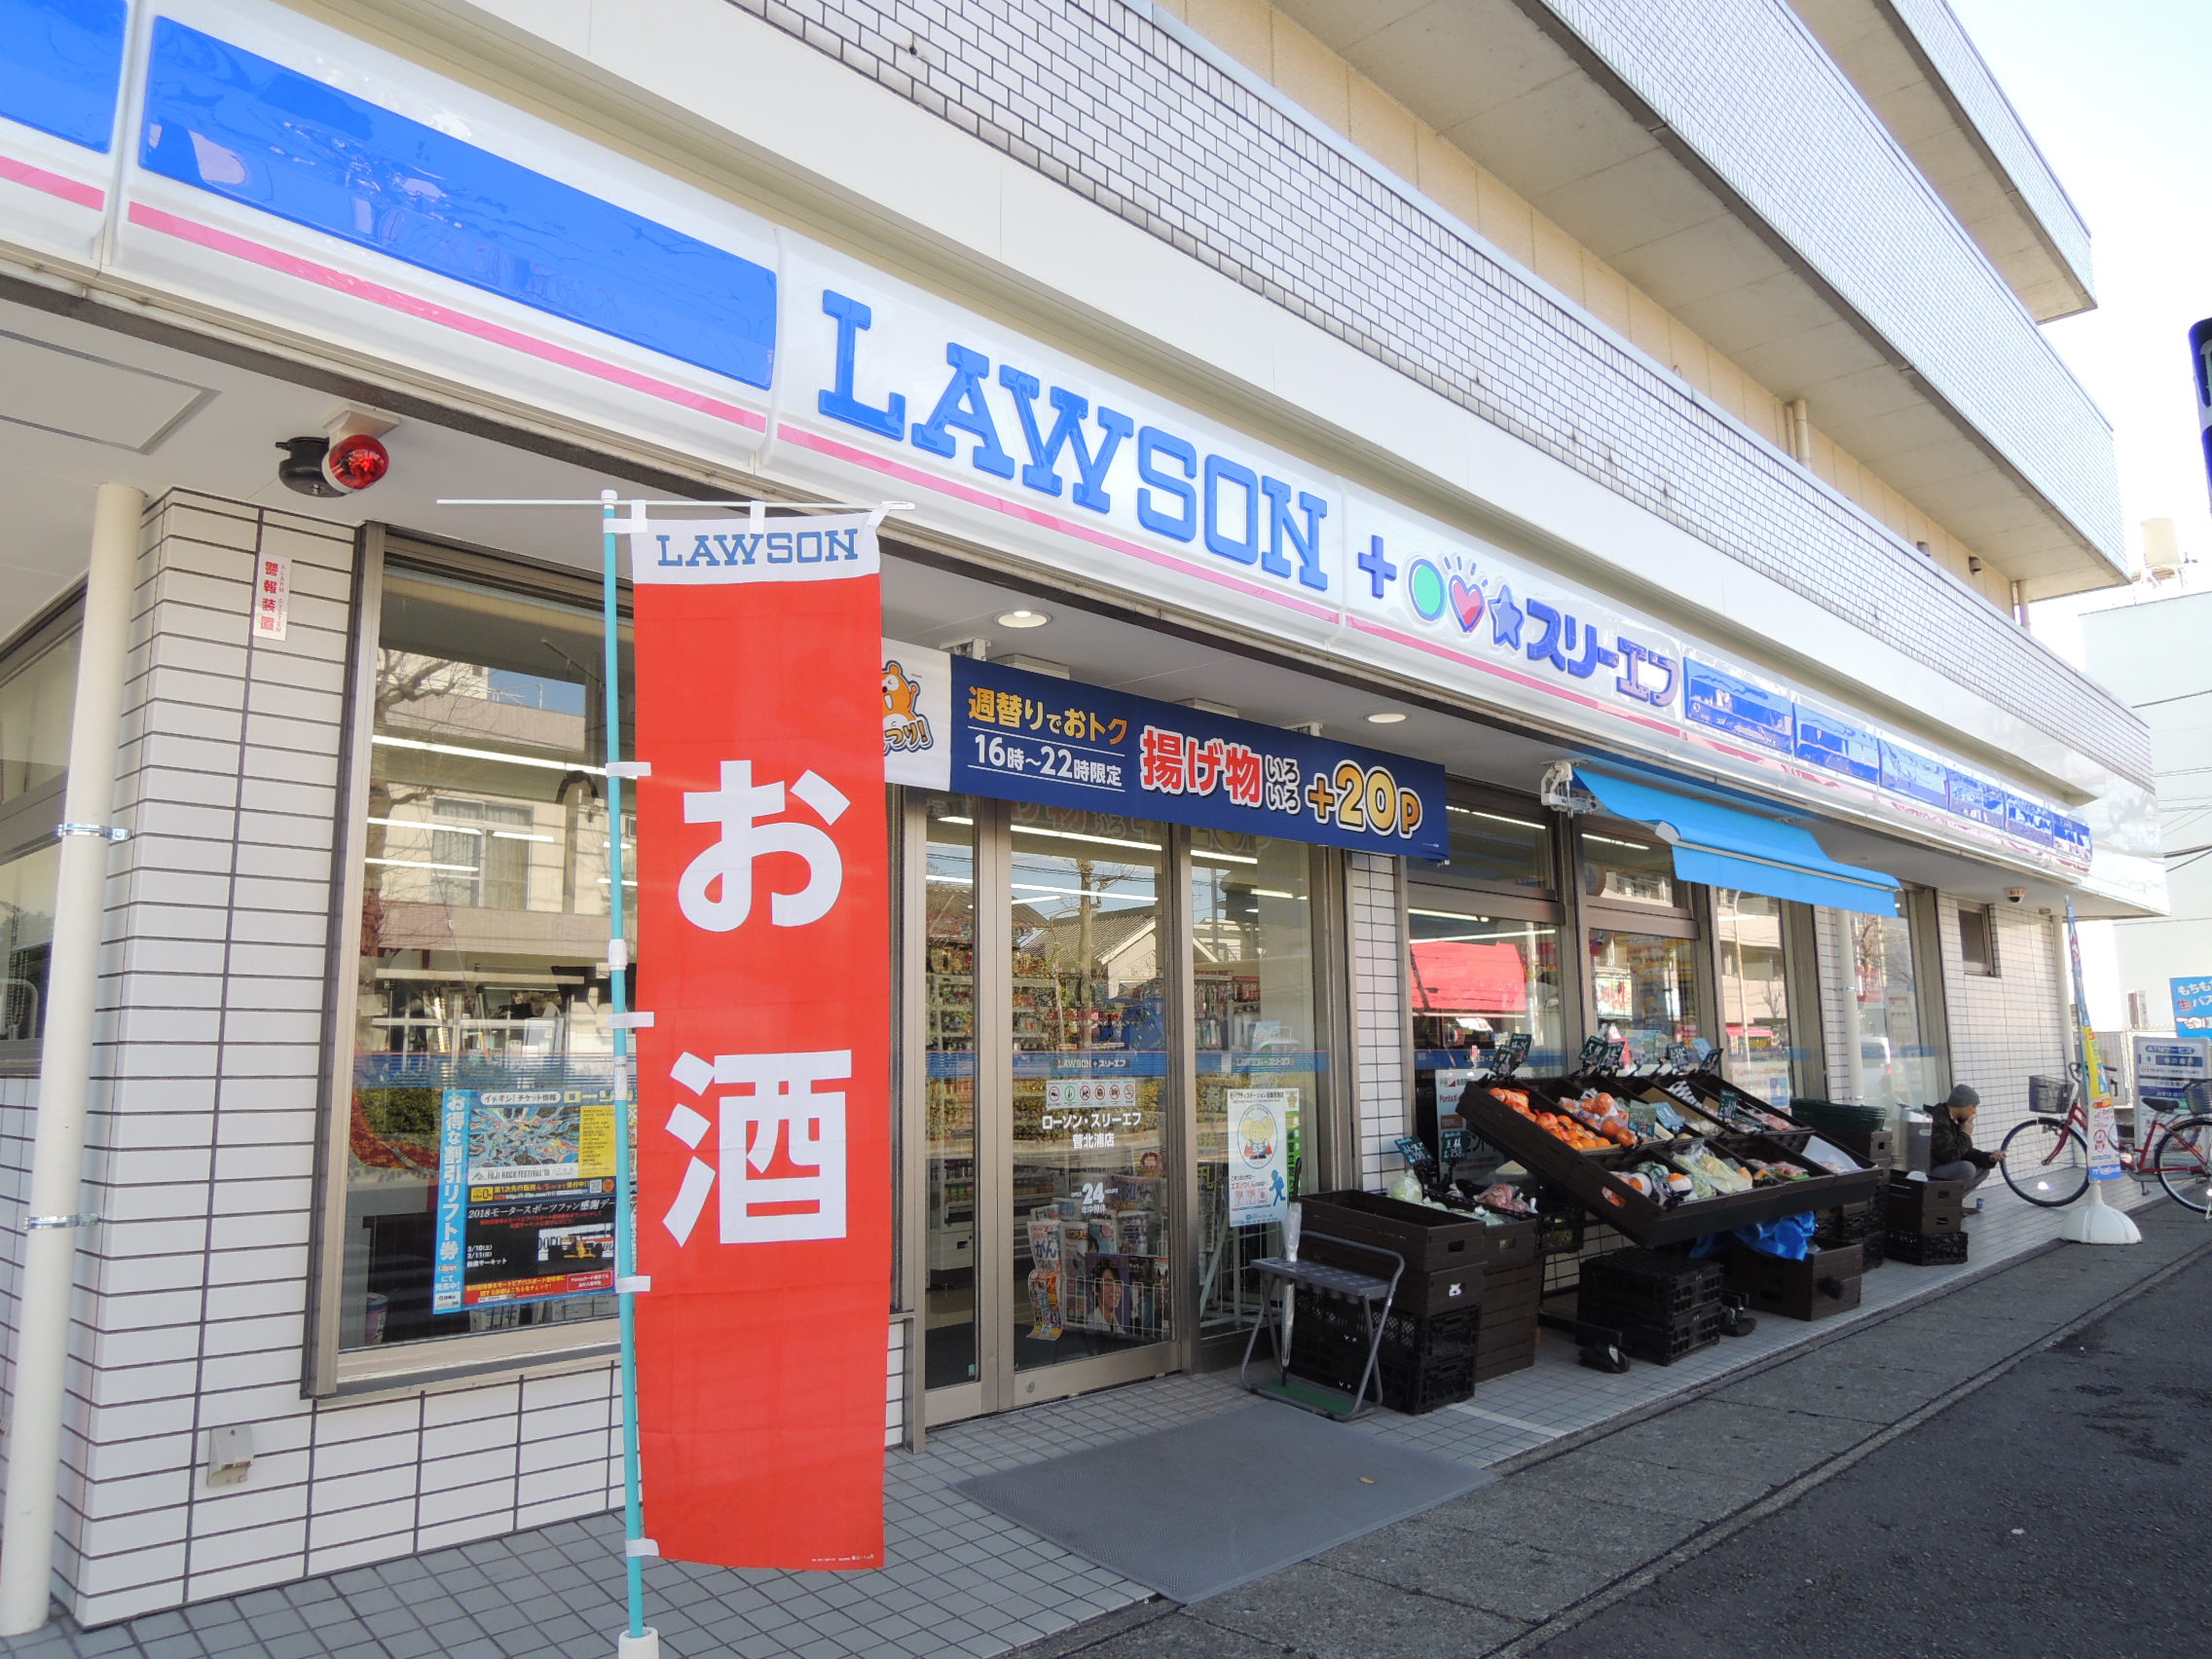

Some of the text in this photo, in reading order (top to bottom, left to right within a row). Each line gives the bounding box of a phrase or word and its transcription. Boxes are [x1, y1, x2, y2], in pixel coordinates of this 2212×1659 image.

[819, 289, 1328, 591] LAWSON
[656, 529, 859, 567] LAWSON
[1527, 598, 1679, 707] スリーエフ
[884, 719, 932, 756] つり!
[968, 685, 1128, 746] 週替りでおトク
[1139, 725, 1264, 808] 揚げ物
[662, 758, 852, 1248] お酒
[1043, 1113, 1141, 1129] ローソン・スリーエフ
[1082, 1182, 1105, 1204] 24
